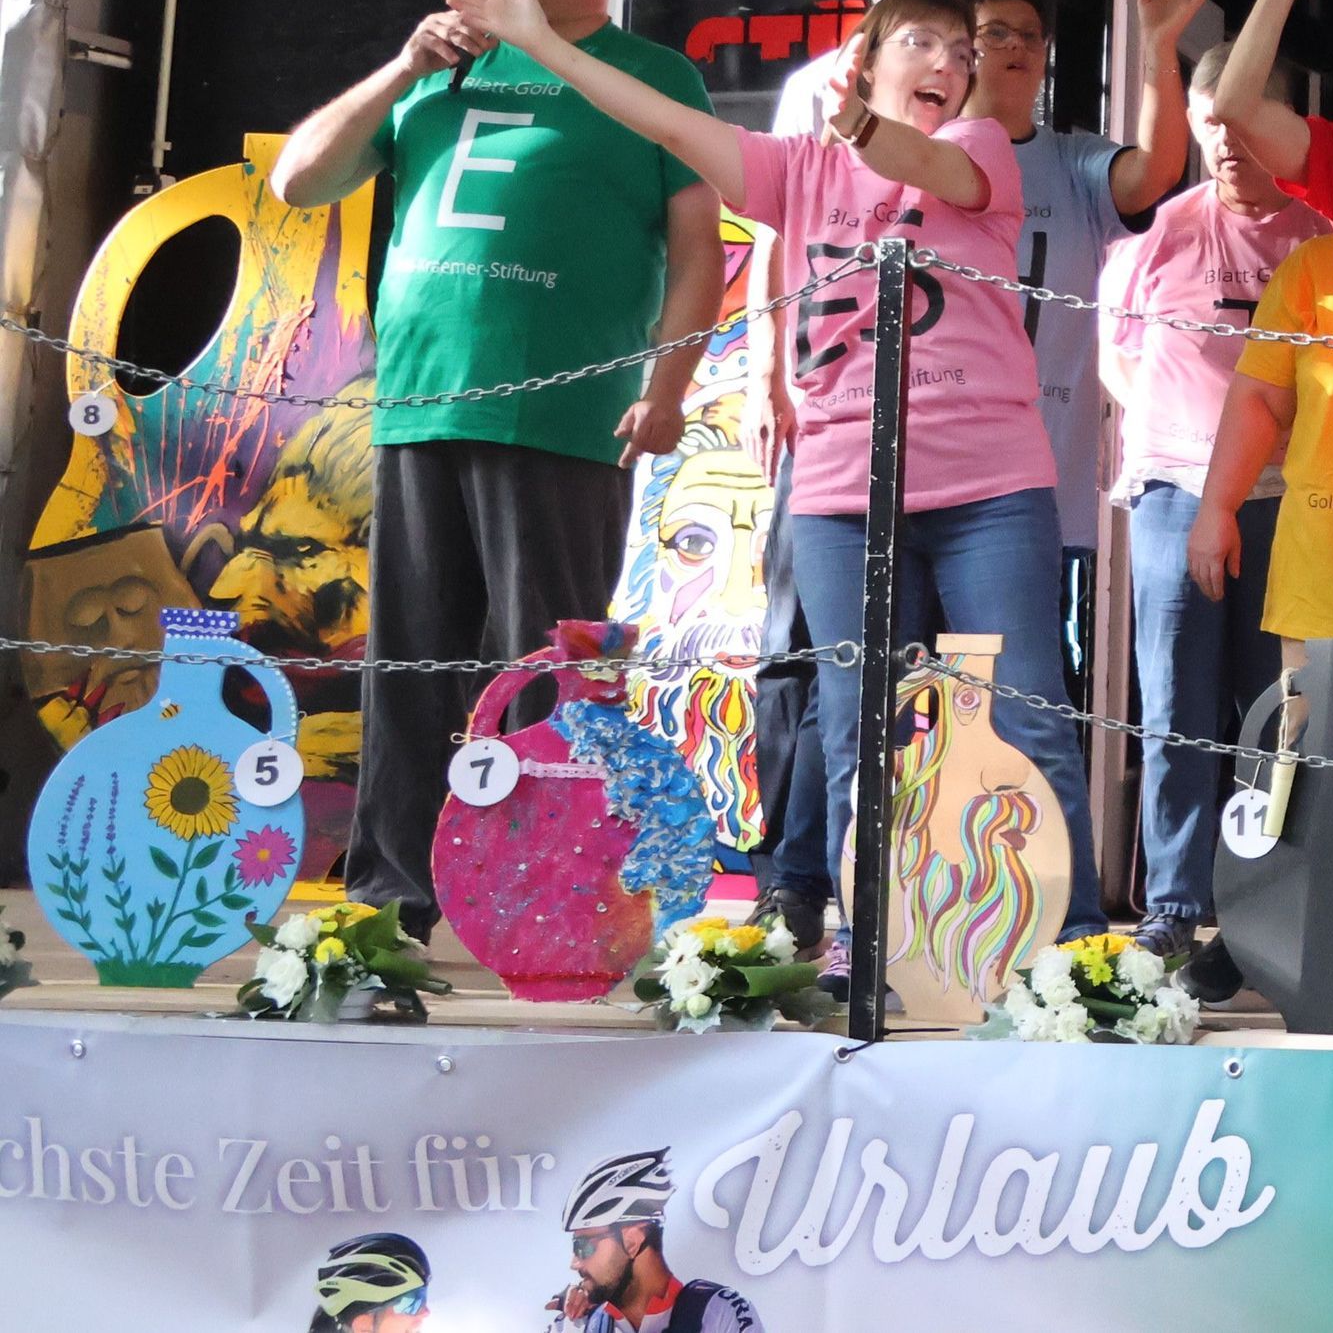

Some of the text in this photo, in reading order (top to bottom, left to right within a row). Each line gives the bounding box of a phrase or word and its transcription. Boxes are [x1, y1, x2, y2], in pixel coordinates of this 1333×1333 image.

[461, 76, 564, 96] Blatt-Gold
[436, 108, 535, 231] E
[1204, 266, 1271, 284] Blatt-G
[83, 405, 100, 424] 8
[254, 755, 280, 785] 5
[470, 757, 495, 789] 7
[1230, 804, 1268, 836] 11
[219, 1137, 392, 1214] Zeit
[408, 1134, 556, 1212] für
[694, 1099, 1276, 1276] Urlaub
